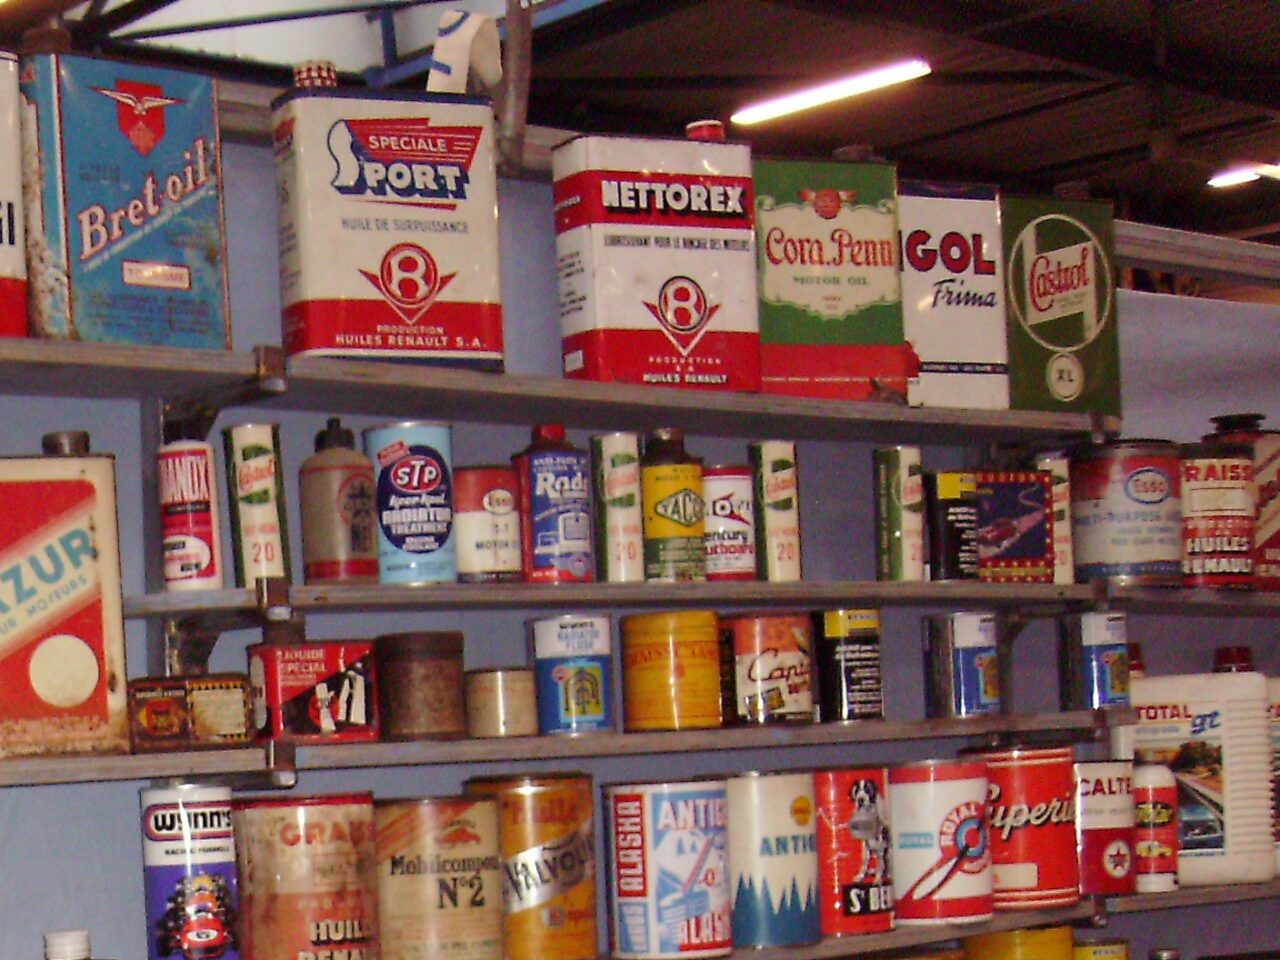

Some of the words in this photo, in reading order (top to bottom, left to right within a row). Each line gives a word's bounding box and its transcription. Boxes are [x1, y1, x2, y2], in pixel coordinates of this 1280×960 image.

[368, 135, 448, 152] SPECIALE
[327, 118, 470, 199] SPORT
[601, 180, 745, 215] NETTOREX
[341, 216, 372, 231] HUILE
[375, 218, 390, 232] DE
[898, 229, 996, 275] GOL
[1029, 246, 1090, 312] Castrol
[388, 336, 448, 347] RENAULT
[395, 460, 438, 487] STP
[252, 543, 275, 564] 20
[26, 576, 89, 618] MOTEURS
[1133, 705, 1193, 721] TOTAL
